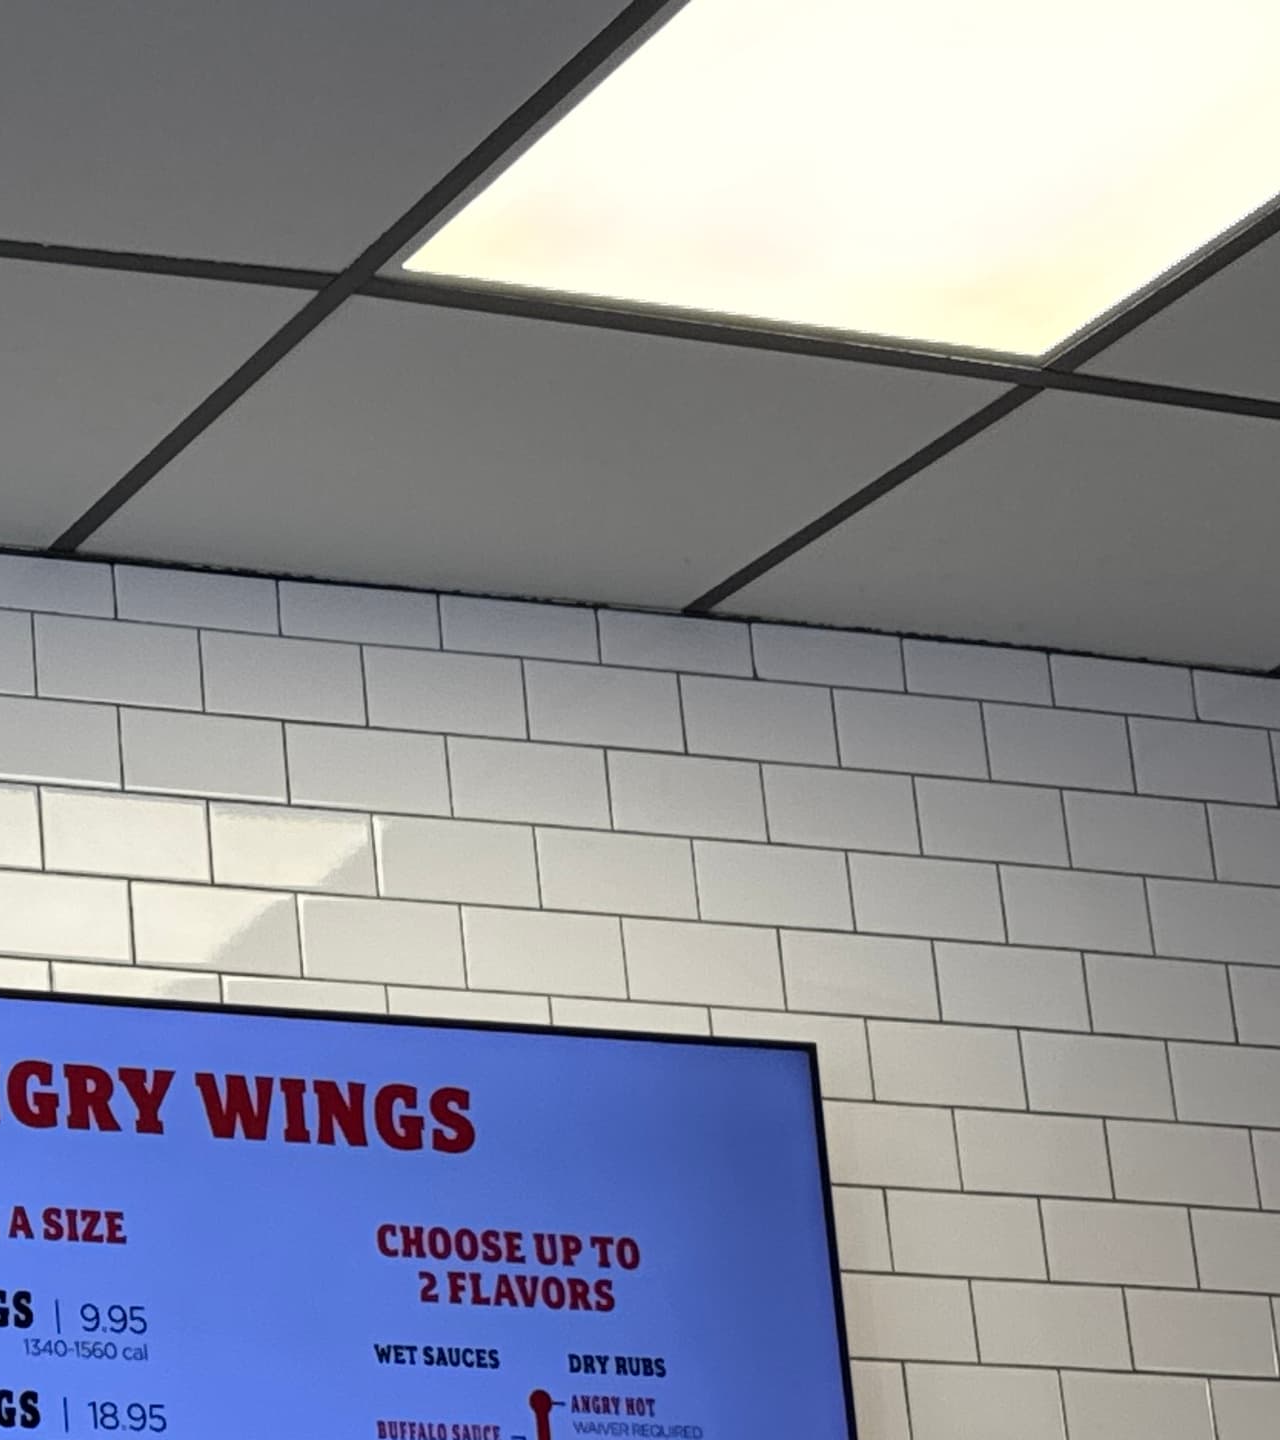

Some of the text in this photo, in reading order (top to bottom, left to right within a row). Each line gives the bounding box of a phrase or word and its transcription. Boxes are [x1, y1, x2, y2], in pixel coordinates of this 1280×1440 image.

[195, 1073, 475, 1154] WINGS
[9, 1206, 34, 1239] A
[42, 1208, 126, 1244] SIZE
[378, 1224, 640, 1270] CHOOSE UP TO
[419, 1272, 615, 1312] 2 FLAVORS
[80, 1304, 147, 1334] 9.95
[374, 1344, 500, 1369] WET SAUCES
[568, 1354, 666, 1377] DRY RUBS
[88, 1402, 167, 1432] 18.95
